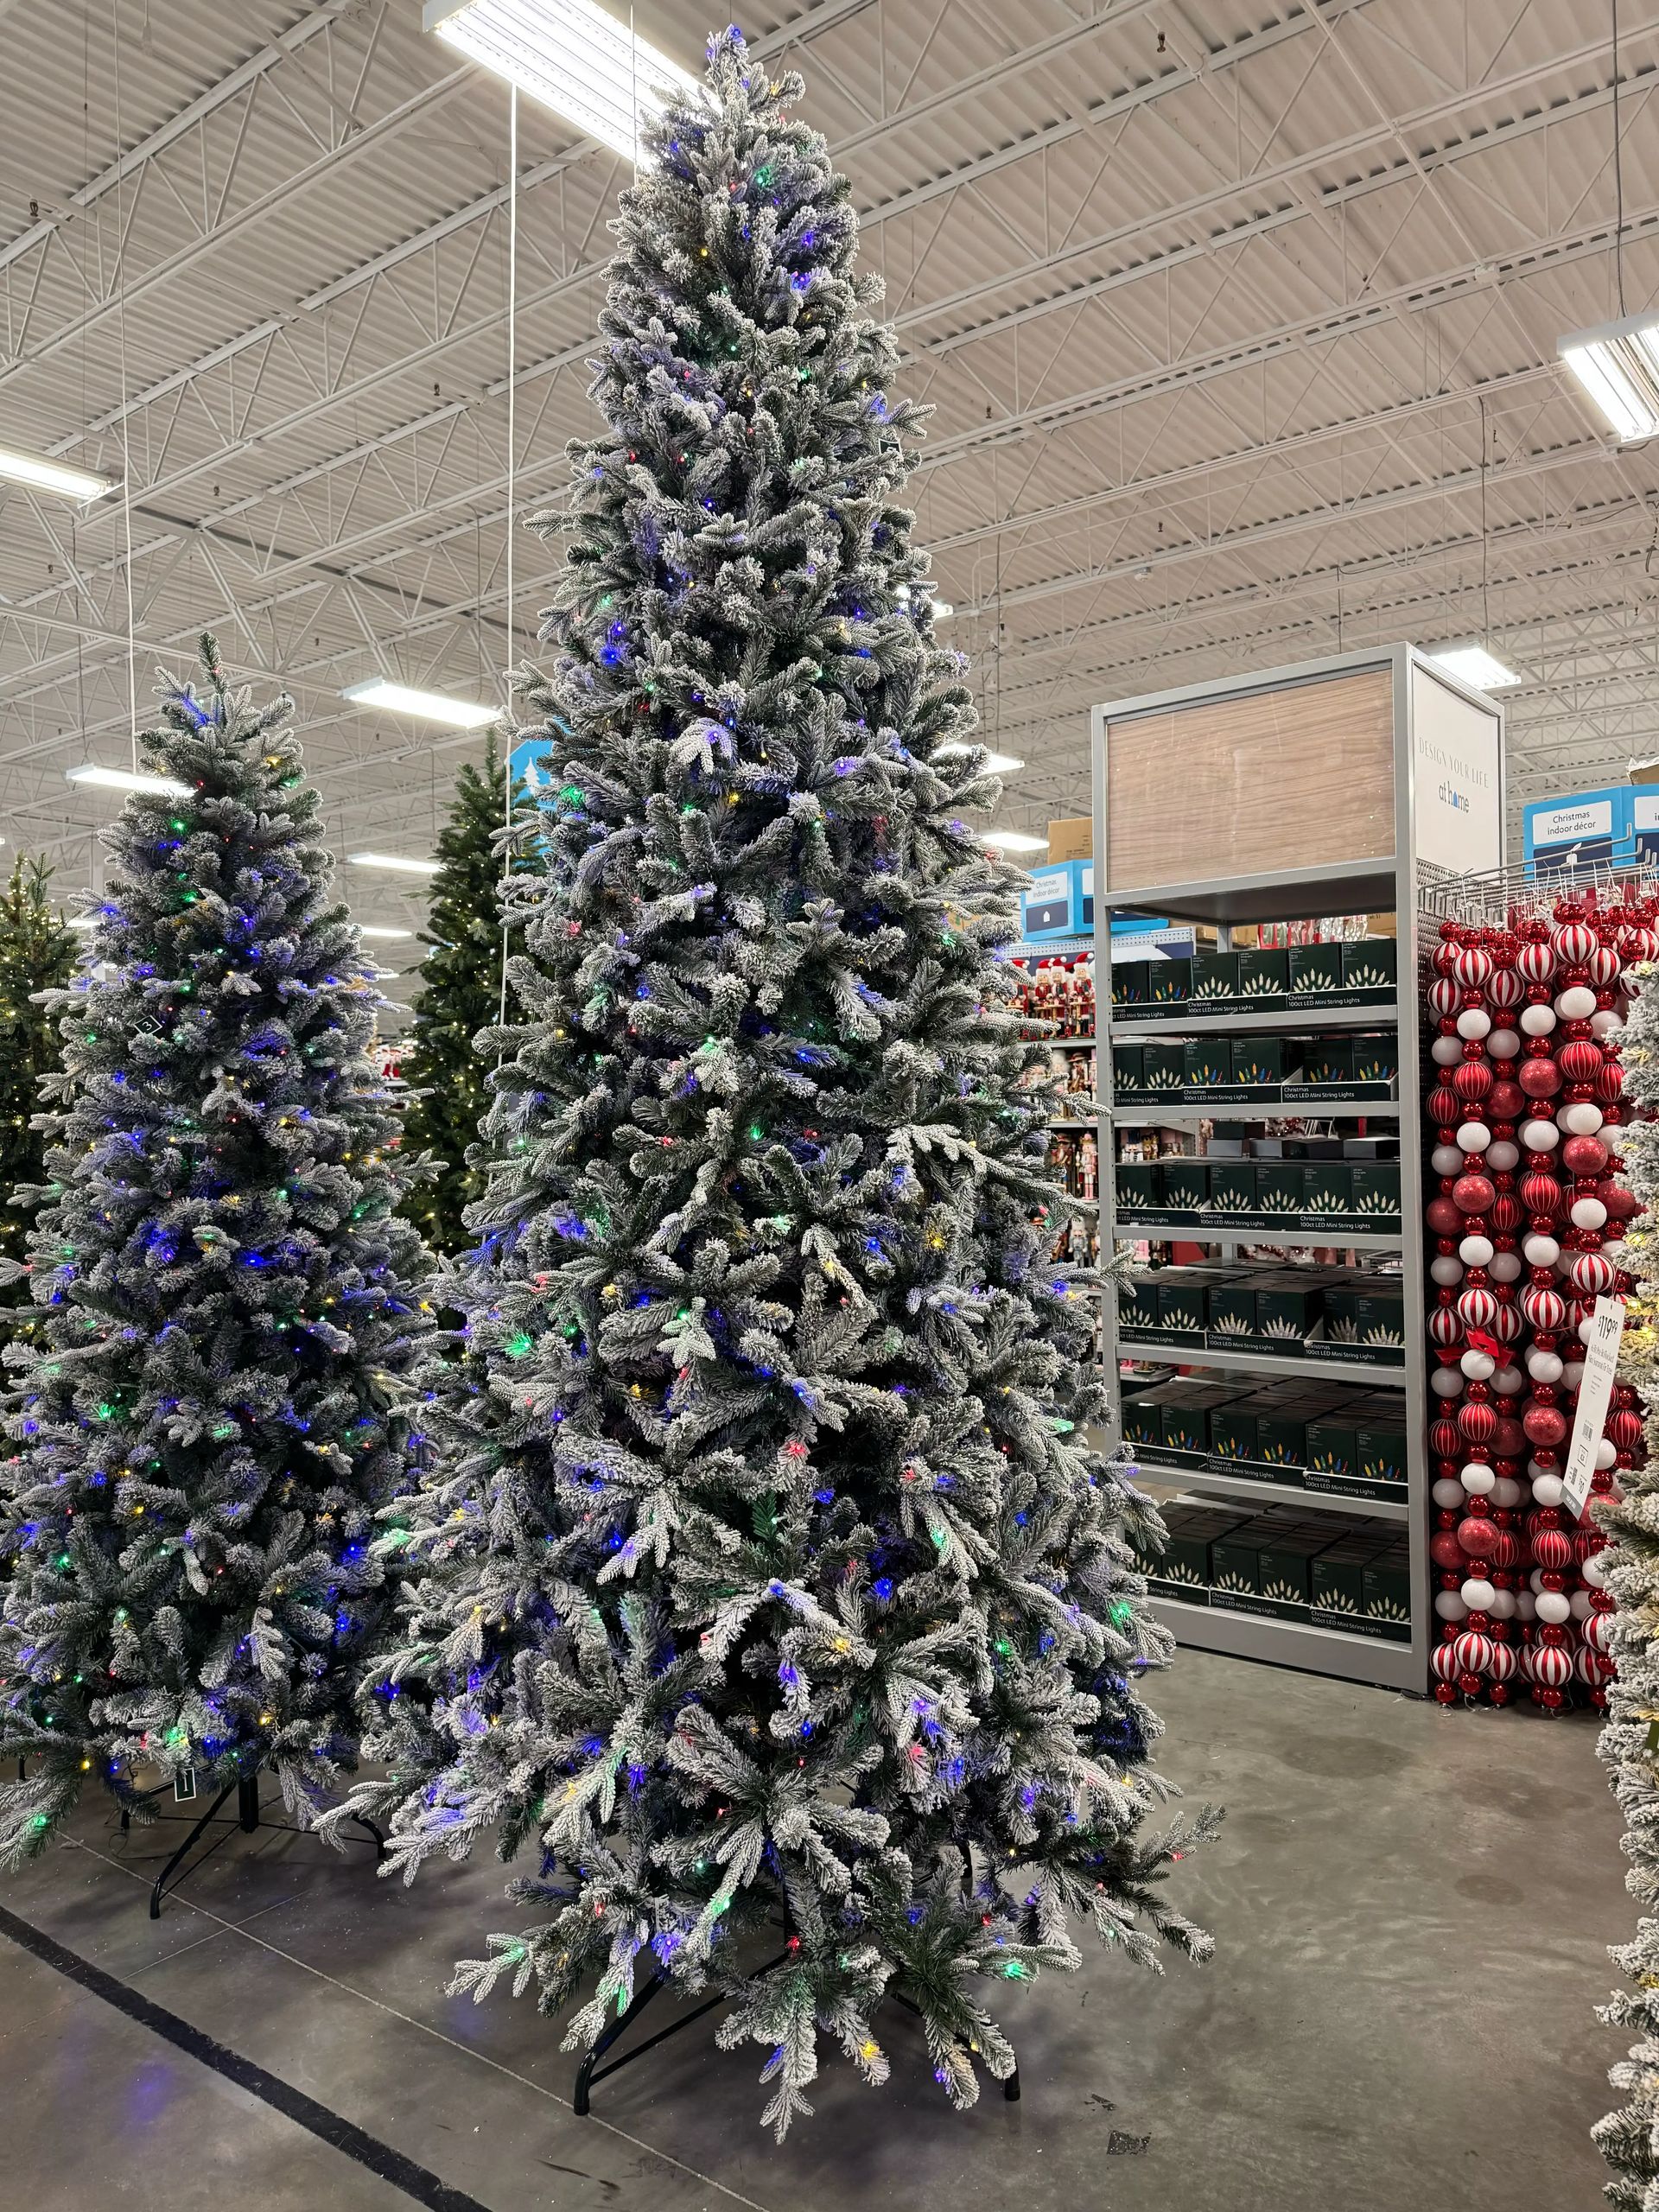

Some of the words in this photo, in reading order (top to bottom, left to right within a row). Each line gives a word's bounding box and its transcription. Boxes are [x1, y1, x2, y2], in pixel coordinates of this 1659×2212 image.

[1420, 737, 1446, 768] DESIGN
[1450, 755, 1470, 779] YOUR
[1472, 768, 1489, 789] LIFE
[1439, 782, 1446, 803] at
[1553, 812, 1590, 823] Christmas
[1548, 826, 1573, 835] indoor
[1574, 822, 1596, 831] décor
[143, 1021, 152, 1031] 3
[1212, 1592, 1235, 1601] Christmas
[1312, 1611, 1336, 1619] Christmas
